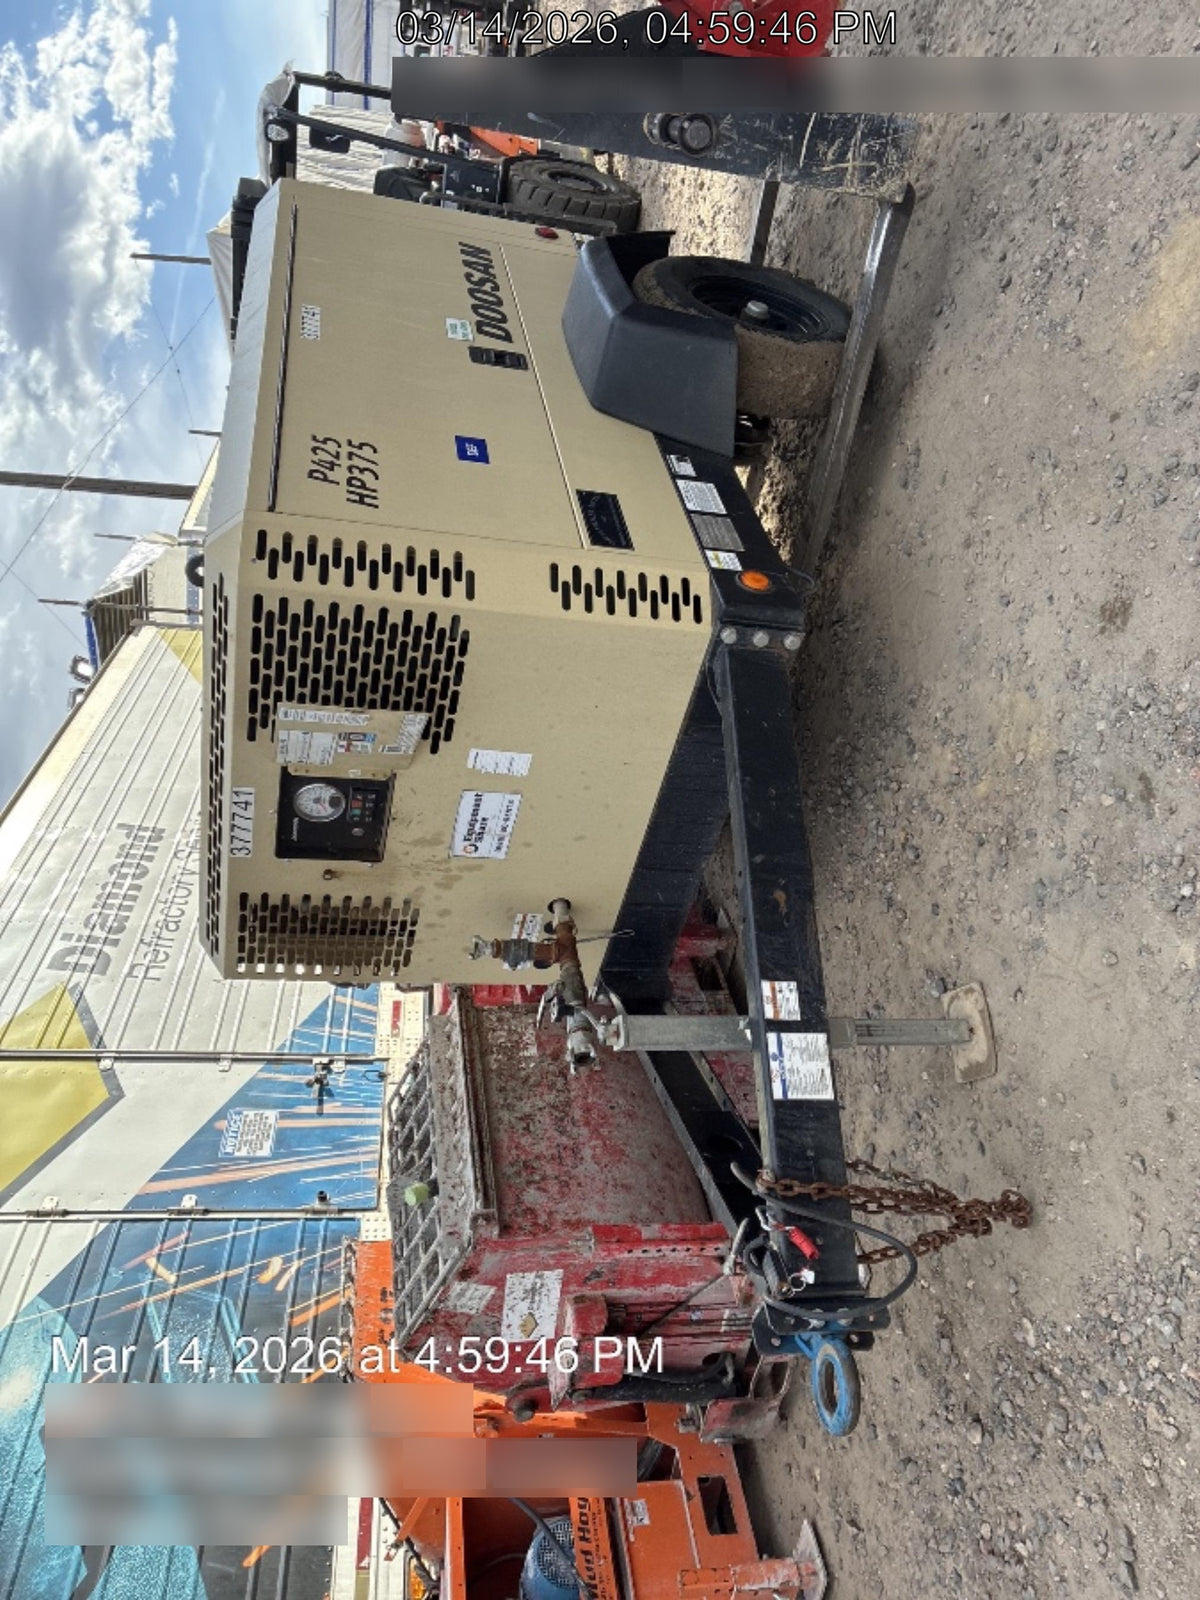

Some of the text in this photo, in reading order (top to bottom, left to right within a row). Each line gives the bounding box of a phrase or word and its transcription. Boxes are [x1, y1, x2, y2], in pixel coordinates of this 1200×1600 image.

[458, 241, 513, 343] DOOSAN
[307, 434, 341, 486] P425
[346, 438, 379, 509] HP375
[230, 789, 253, 856] 377741
[463, 792, 483, 842] Equipment
[474, 817, 489, 843] Share
[46, 823, 166, 976] Diamond
[125, 865, 200, 982] Refractory
